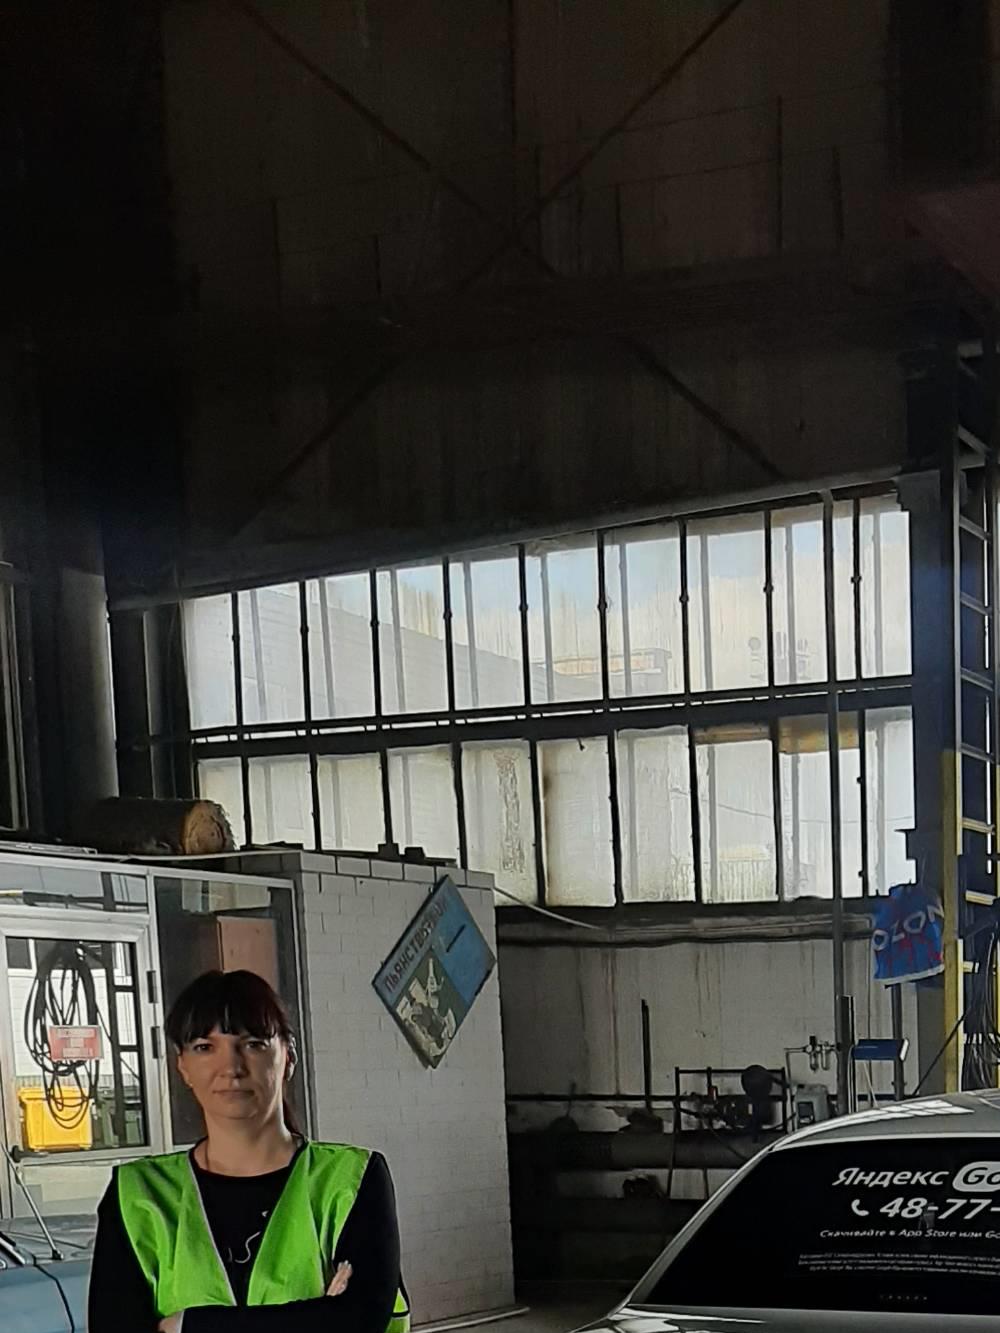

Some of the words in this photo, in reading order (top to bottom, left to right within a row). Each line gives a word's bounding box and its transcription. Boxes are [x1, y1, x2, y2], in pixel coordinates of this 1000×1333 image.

[832, 1166, 951, 1188] Яндекс
[898, 1229, 922, 1238] App
[924, 1229, 957, 1238] Store
